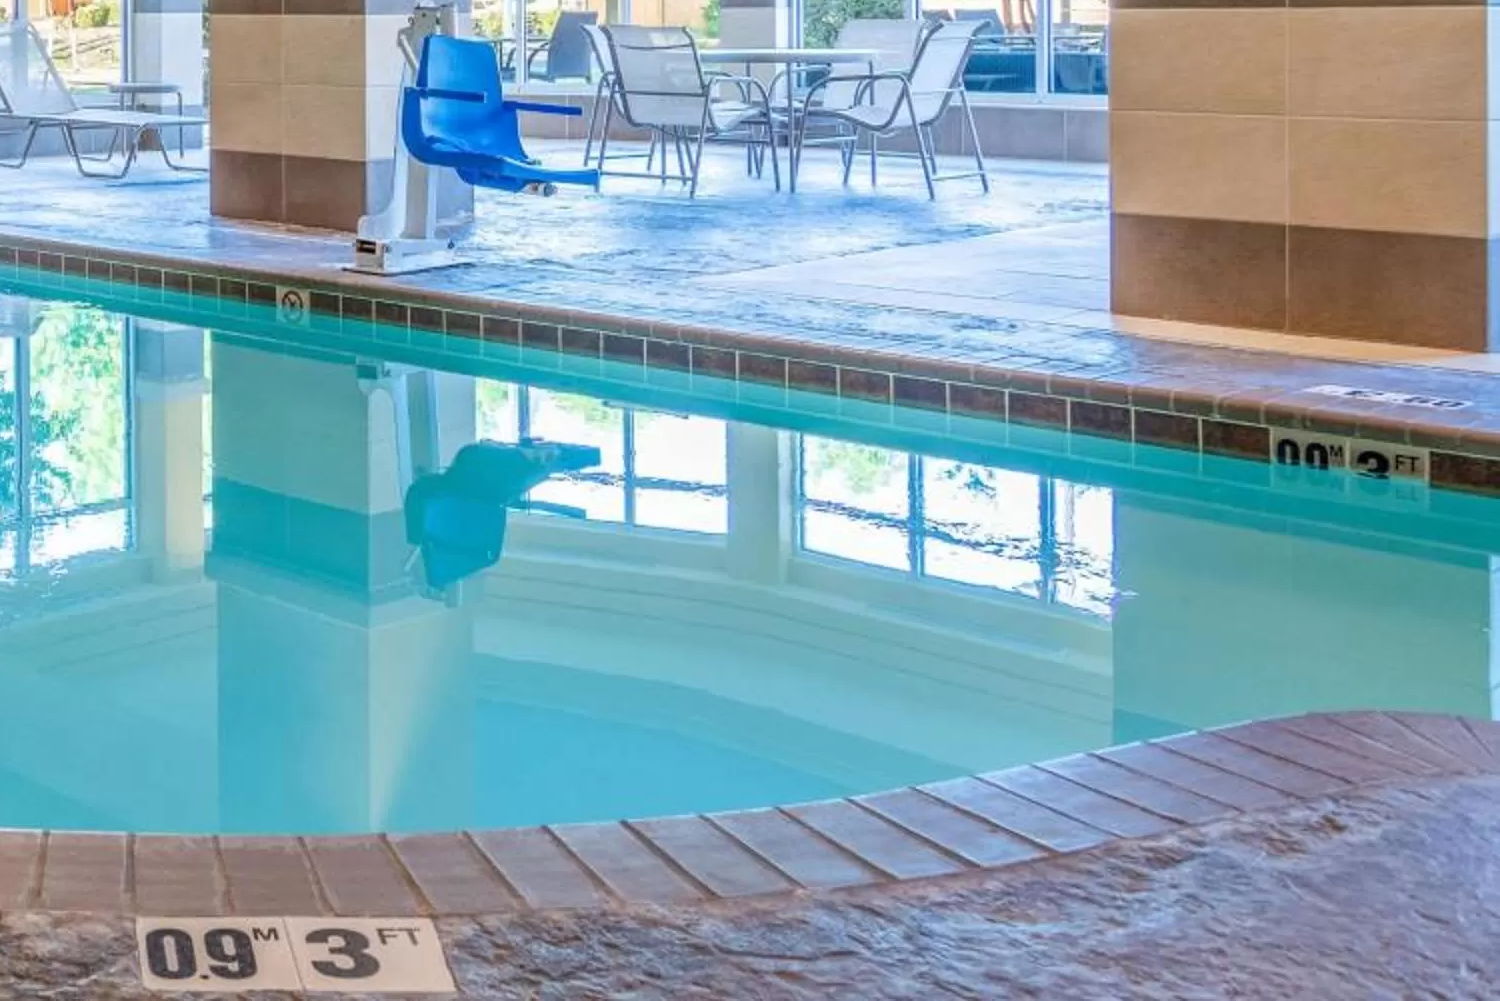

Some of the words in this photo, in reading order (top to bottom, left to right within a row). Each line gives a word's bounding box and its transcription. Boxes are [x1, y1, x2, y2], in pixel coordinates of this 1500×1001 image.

[1395, 454, 1421, 473] FT
[145, 927, 258, 980] 0.9
[304, 927, 381, 980] 3
[375, 926, 421, 947] FT
